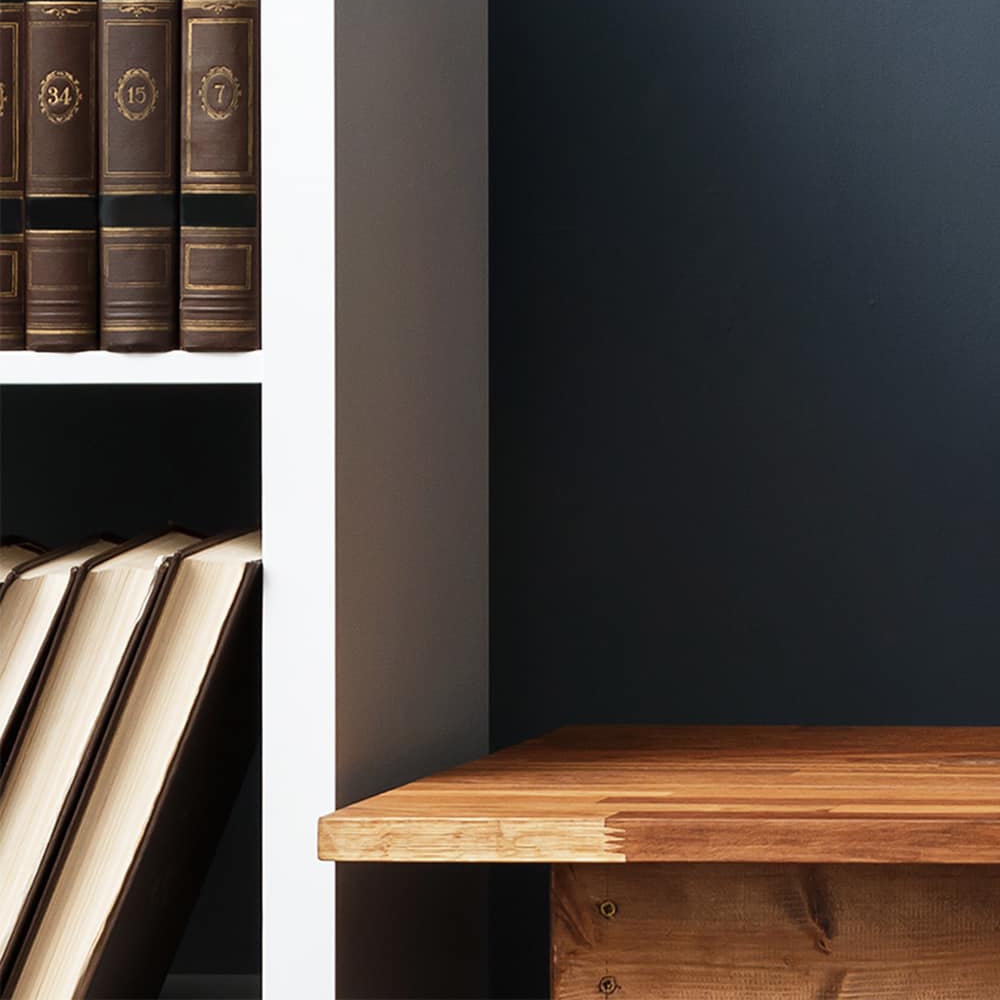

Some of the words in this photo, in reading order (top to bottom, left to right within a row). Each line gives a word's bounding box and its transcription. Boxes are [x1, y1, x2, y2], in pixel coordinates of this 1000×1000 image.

[47, 86, 72, 106] 34
[127, 86, 146, 104] 15
[214, 84, 226, 104] 7
